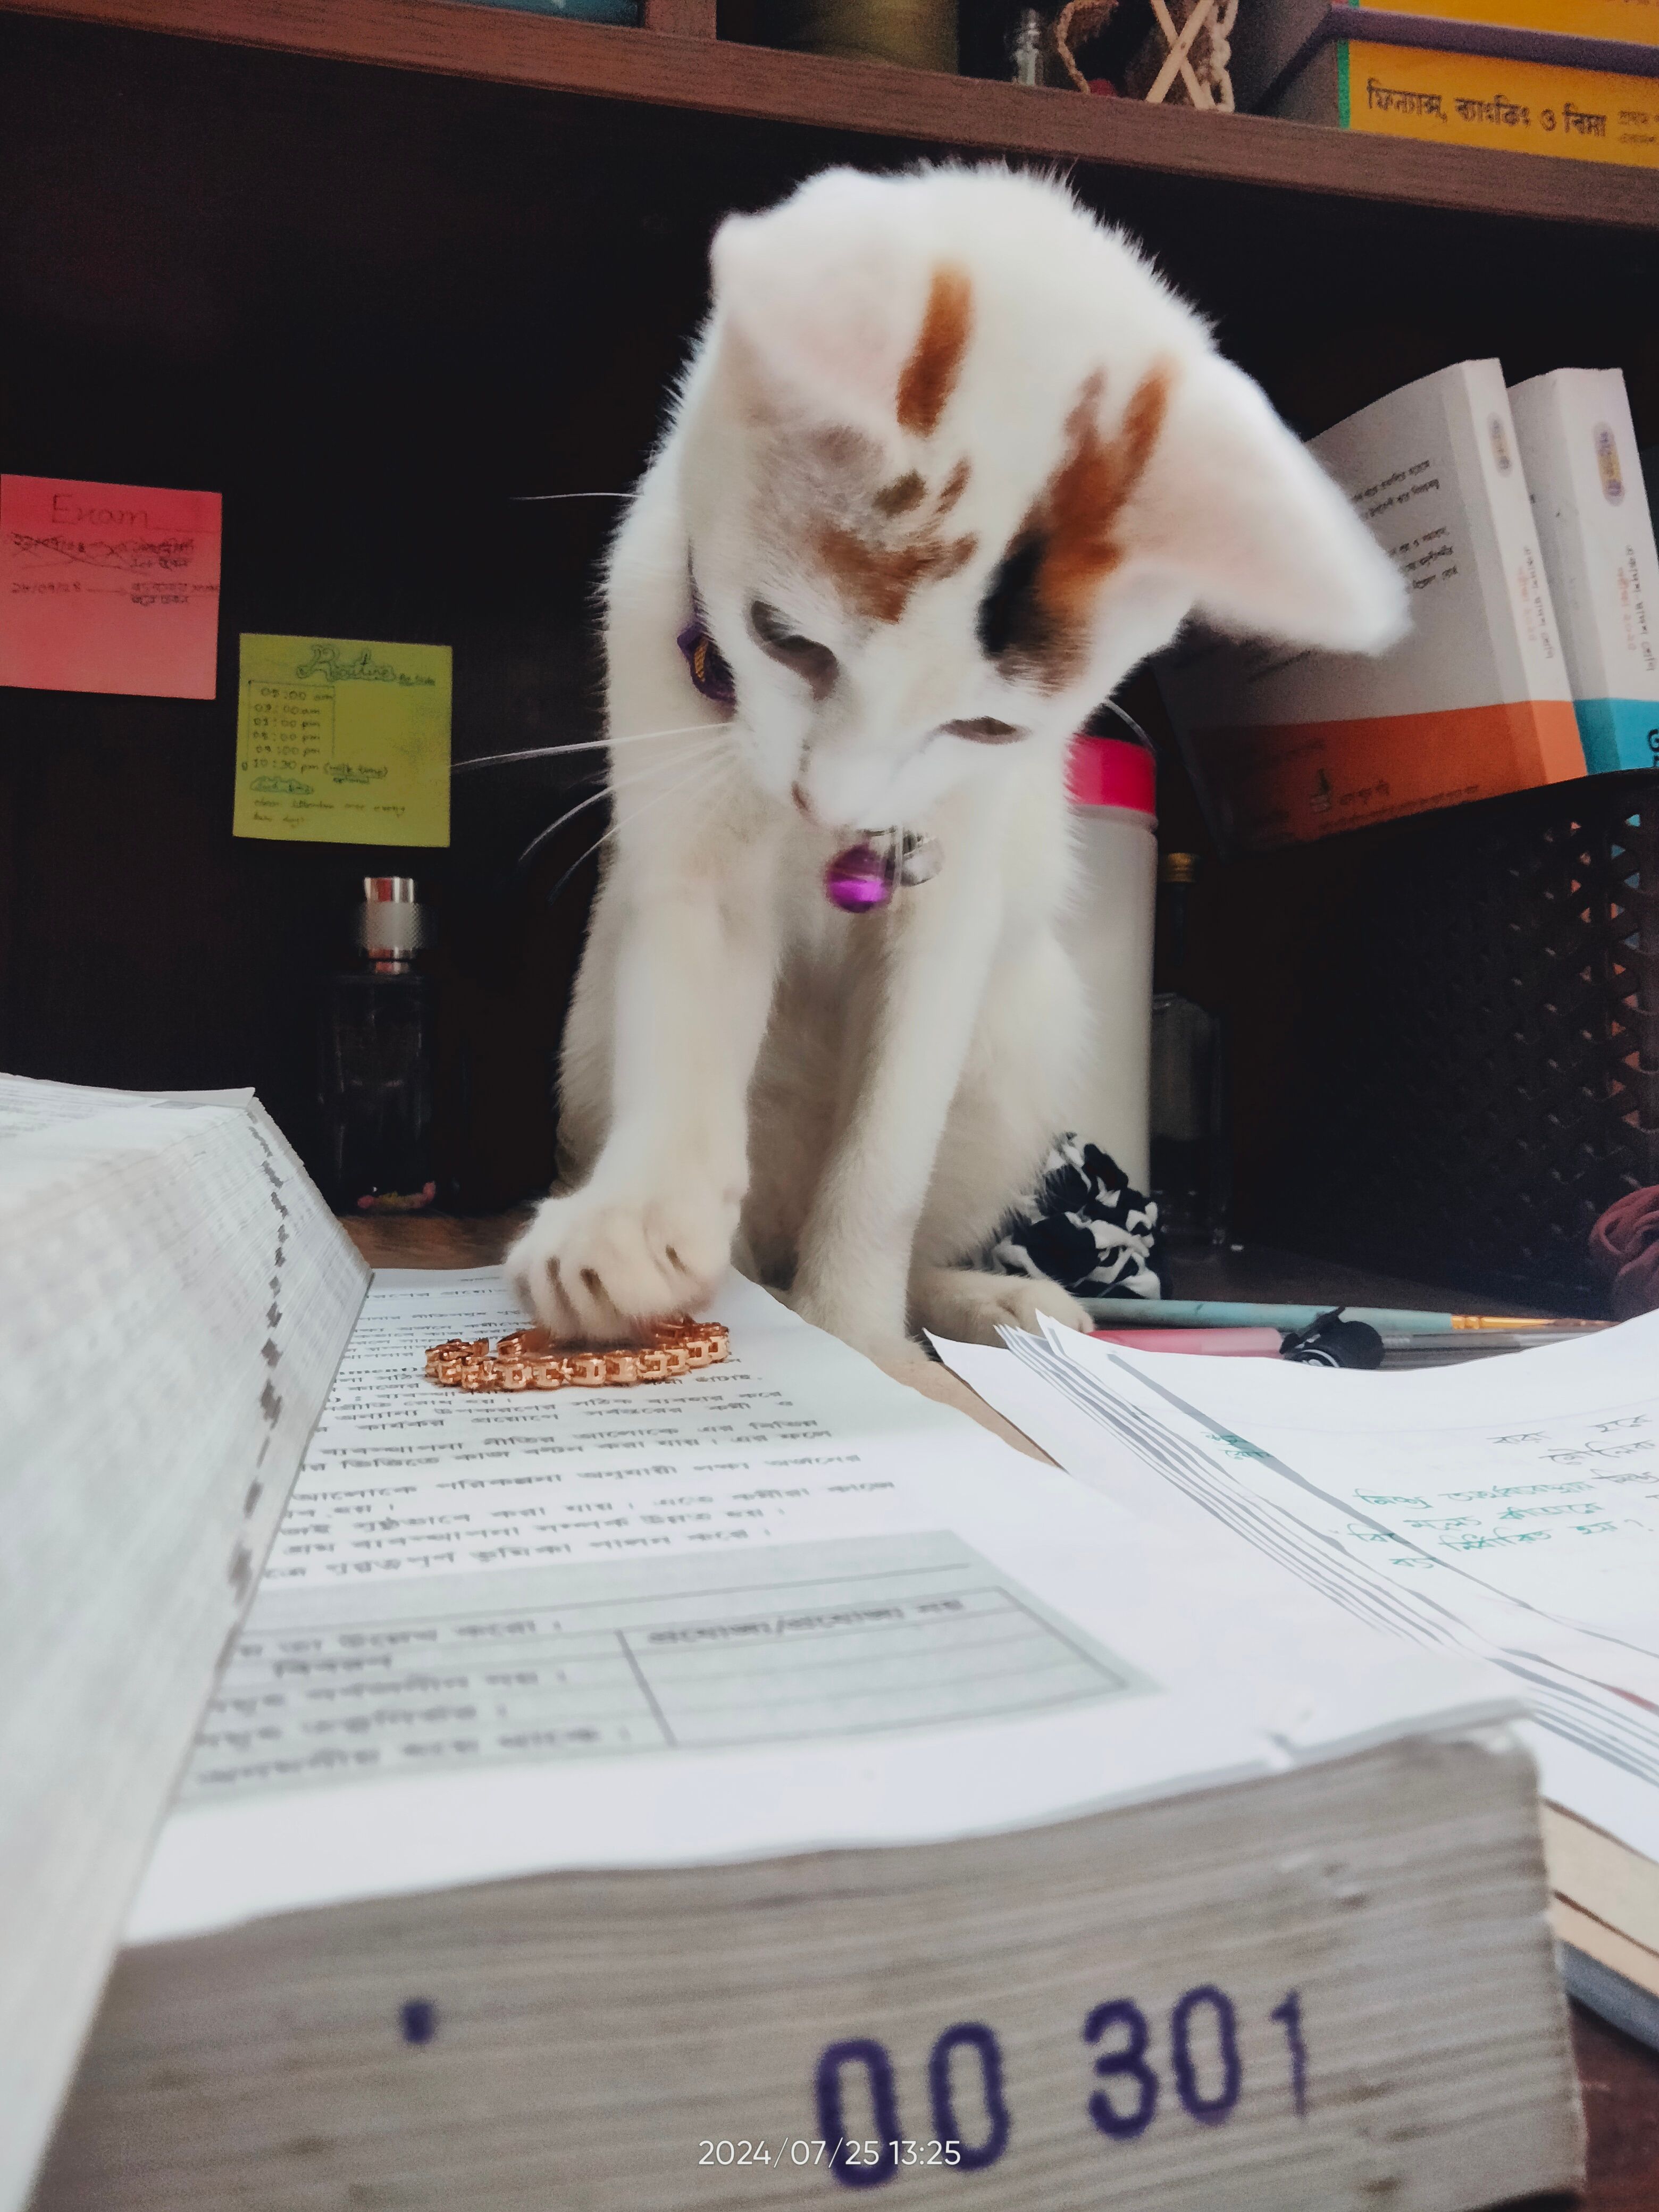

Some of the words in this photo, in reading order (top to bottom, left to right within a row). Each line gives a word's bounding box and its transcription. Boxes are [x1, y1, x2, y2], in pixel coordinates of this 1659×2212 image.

[1541, 107, 1556, 131] ও
[53, 493, 148, 529] Exam
[1084, 1983, 1307, 2140] 301
